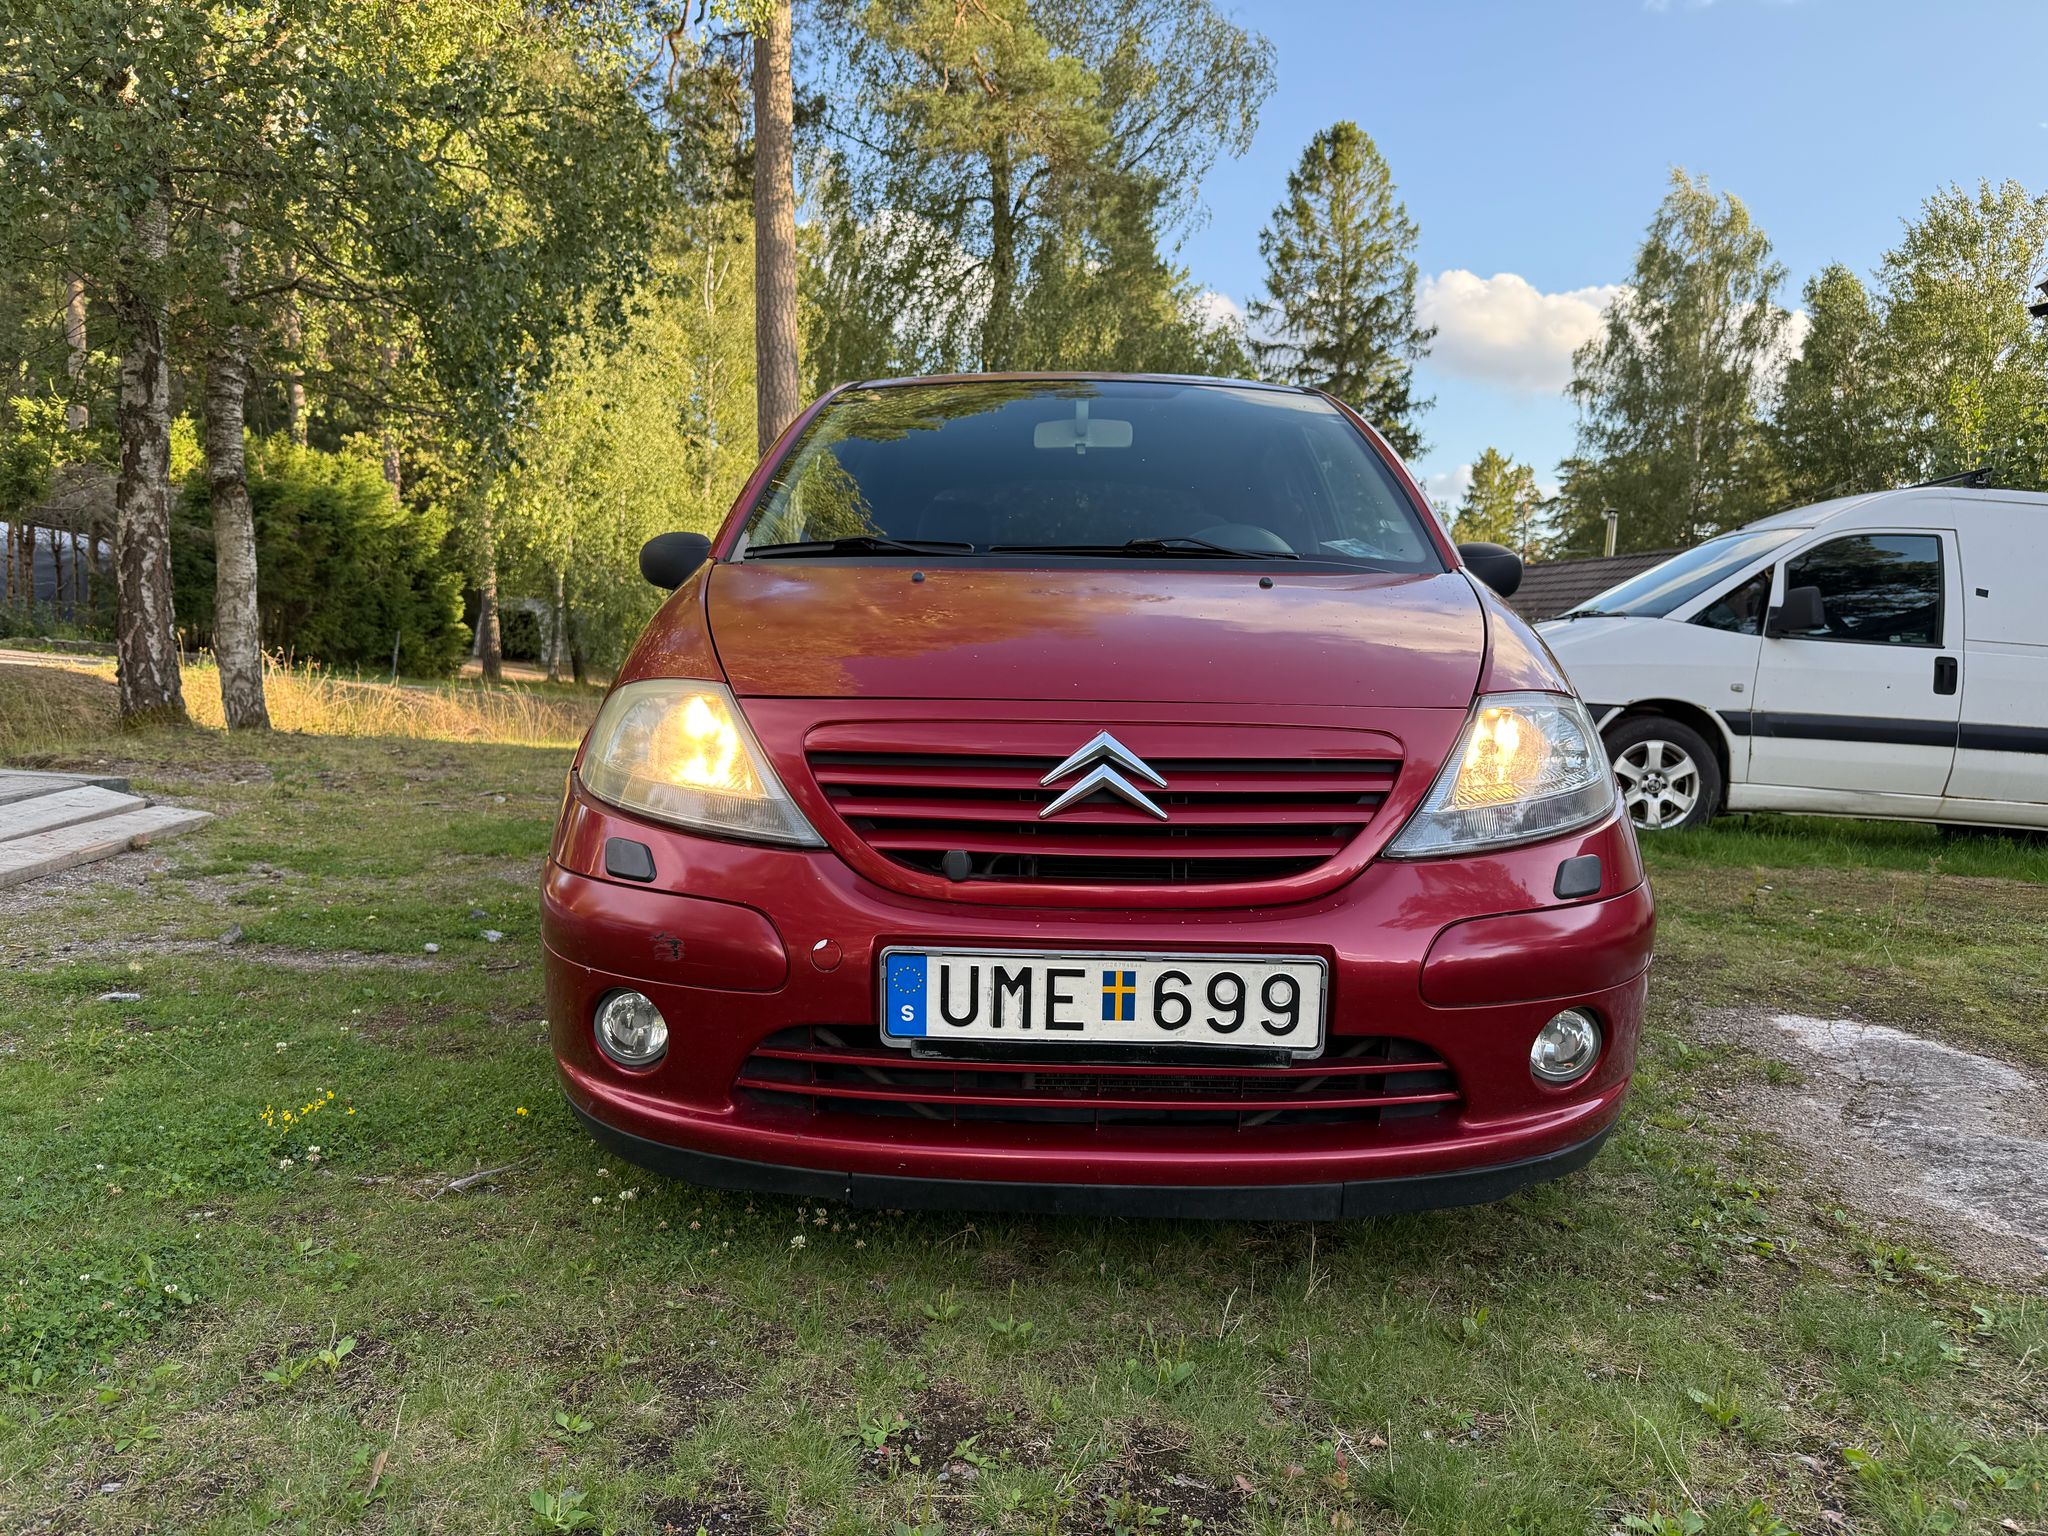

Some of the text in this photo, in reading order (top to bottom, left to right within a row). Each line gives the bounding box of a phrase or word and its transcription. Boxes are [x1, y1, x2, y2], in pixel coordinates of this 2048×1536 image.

[901, 1004, 914, 1022] S
[940, 964, 1301, 1037] UME 699
